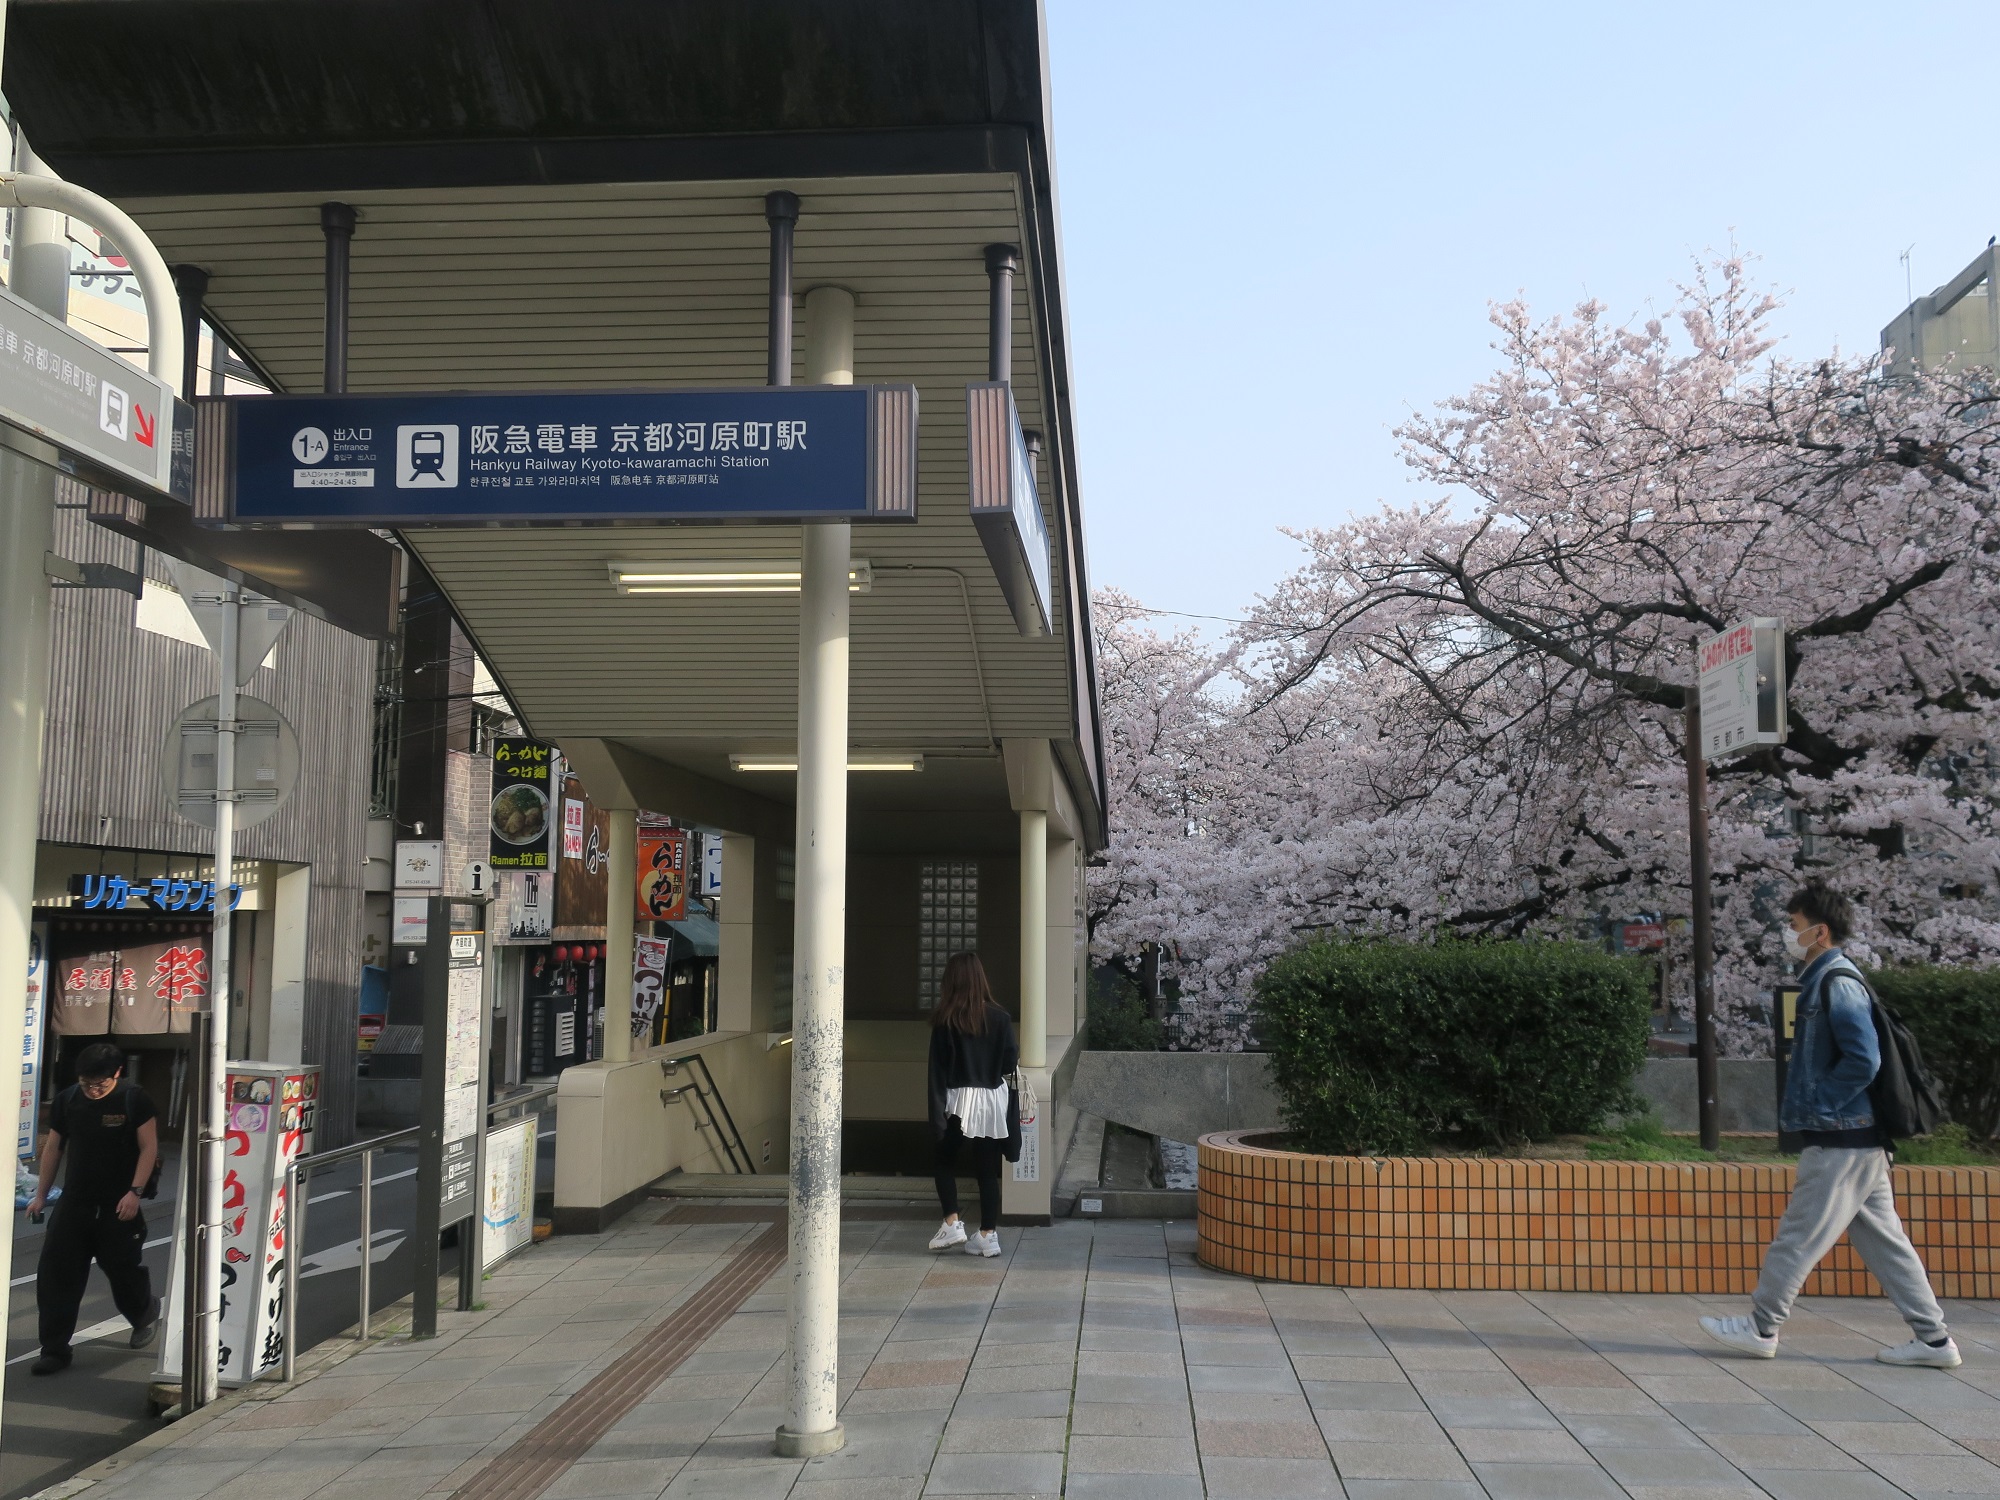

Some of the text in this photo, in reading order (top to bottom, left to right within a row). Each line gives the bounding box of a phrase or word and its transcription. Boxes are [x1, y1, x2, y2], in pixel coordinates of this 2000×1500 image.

[22, 339, 97, 399] 京都河原町駅
[333, 427, 373, 441] 出入口
[470, 420, 807, 455] 阪急電車 京都河原町駅
[298, 434, 325, 458] 1-A
[333, 443, 370, 452] Entrance
[470, 454, 769, 473] Hankyu Railway Kyoto-kawaramachi Station
[470, 474, 600, 488] 한큐전철 교토 가와라마치역
[611, 473, 719, 486] 阪急电车 京都河原町站
[496, 743, 549, 761] らーめん
[565, 833, 582, 853] RAMEN
[491, 855, 519, 866] Ramen
[519, 852, 548, 867] 拉面
[65, 967, 138, 991] 居酒屋
[147, 946, 208, 1004] 祭
